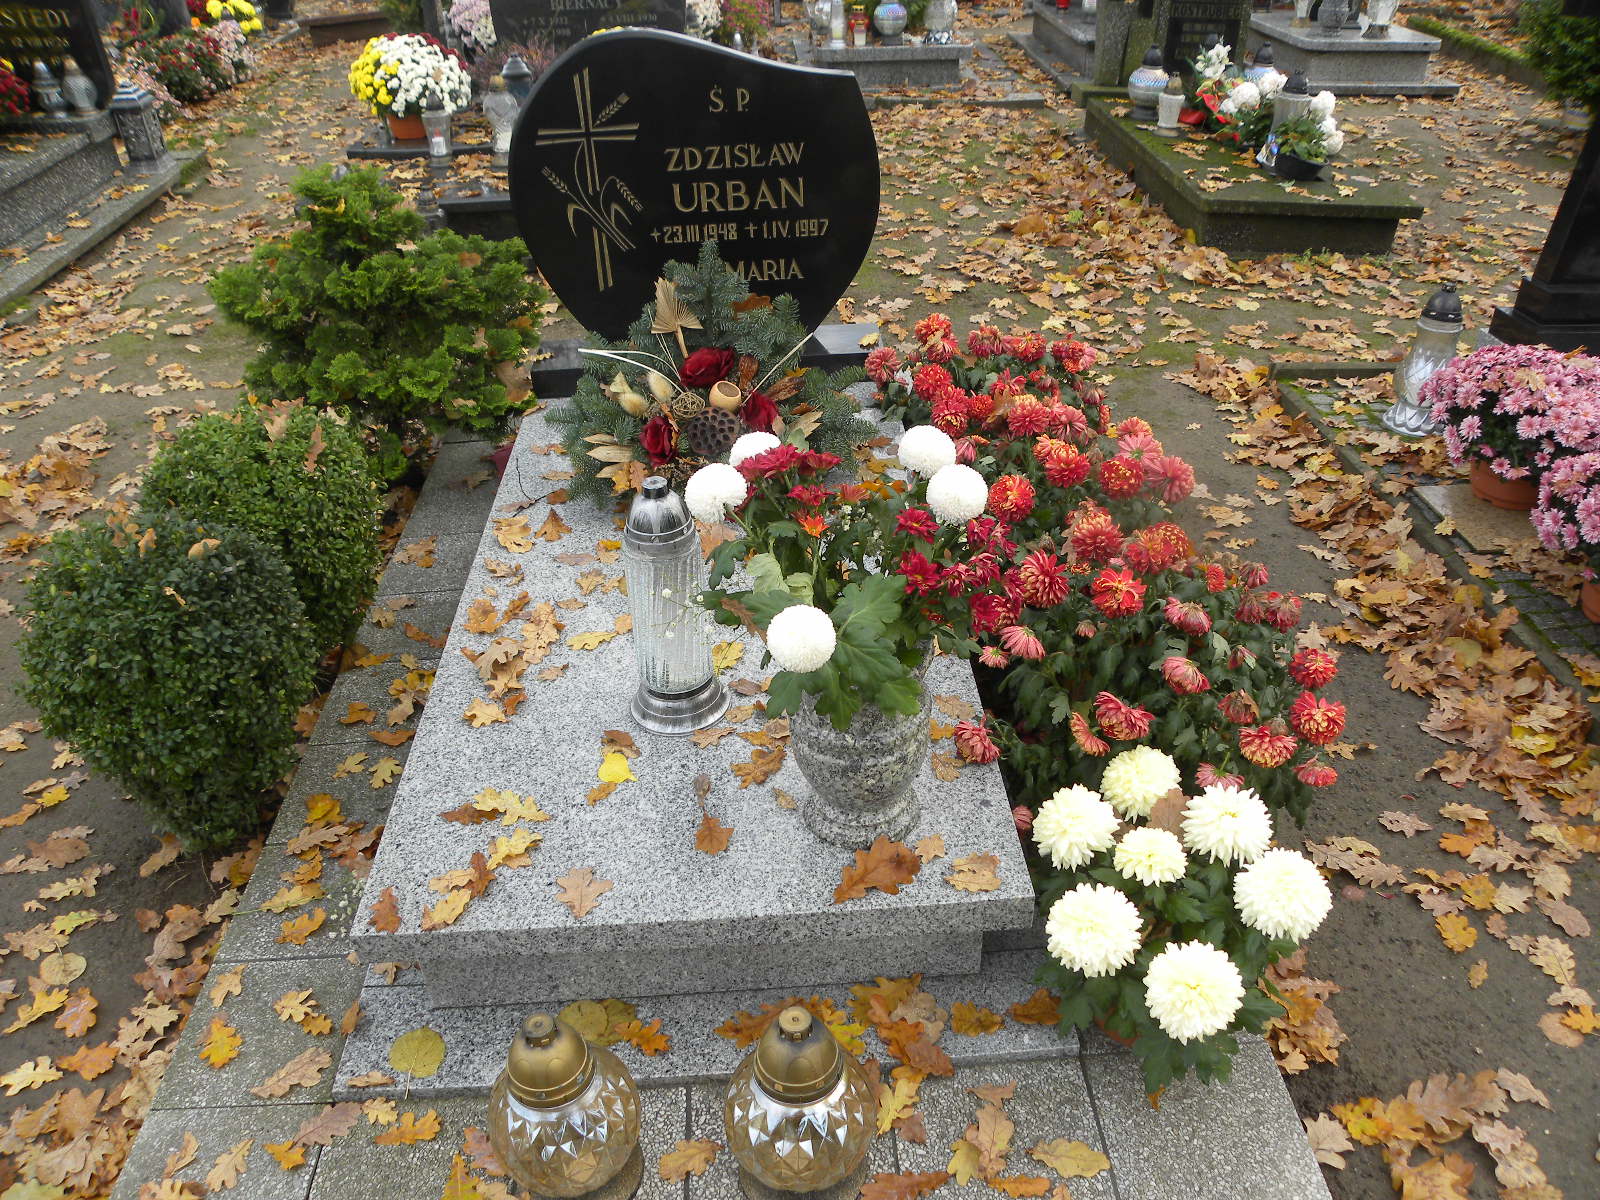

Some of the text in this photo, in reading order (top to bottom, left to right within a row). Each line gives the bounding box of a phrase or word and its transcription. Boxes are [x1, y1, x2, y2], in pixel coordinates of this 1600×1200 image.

[663, 142, 805, 171] ZDZISŁAW
[672, 176, 805, 212] URBAN
[725, 258, 805, 281] MARIA
